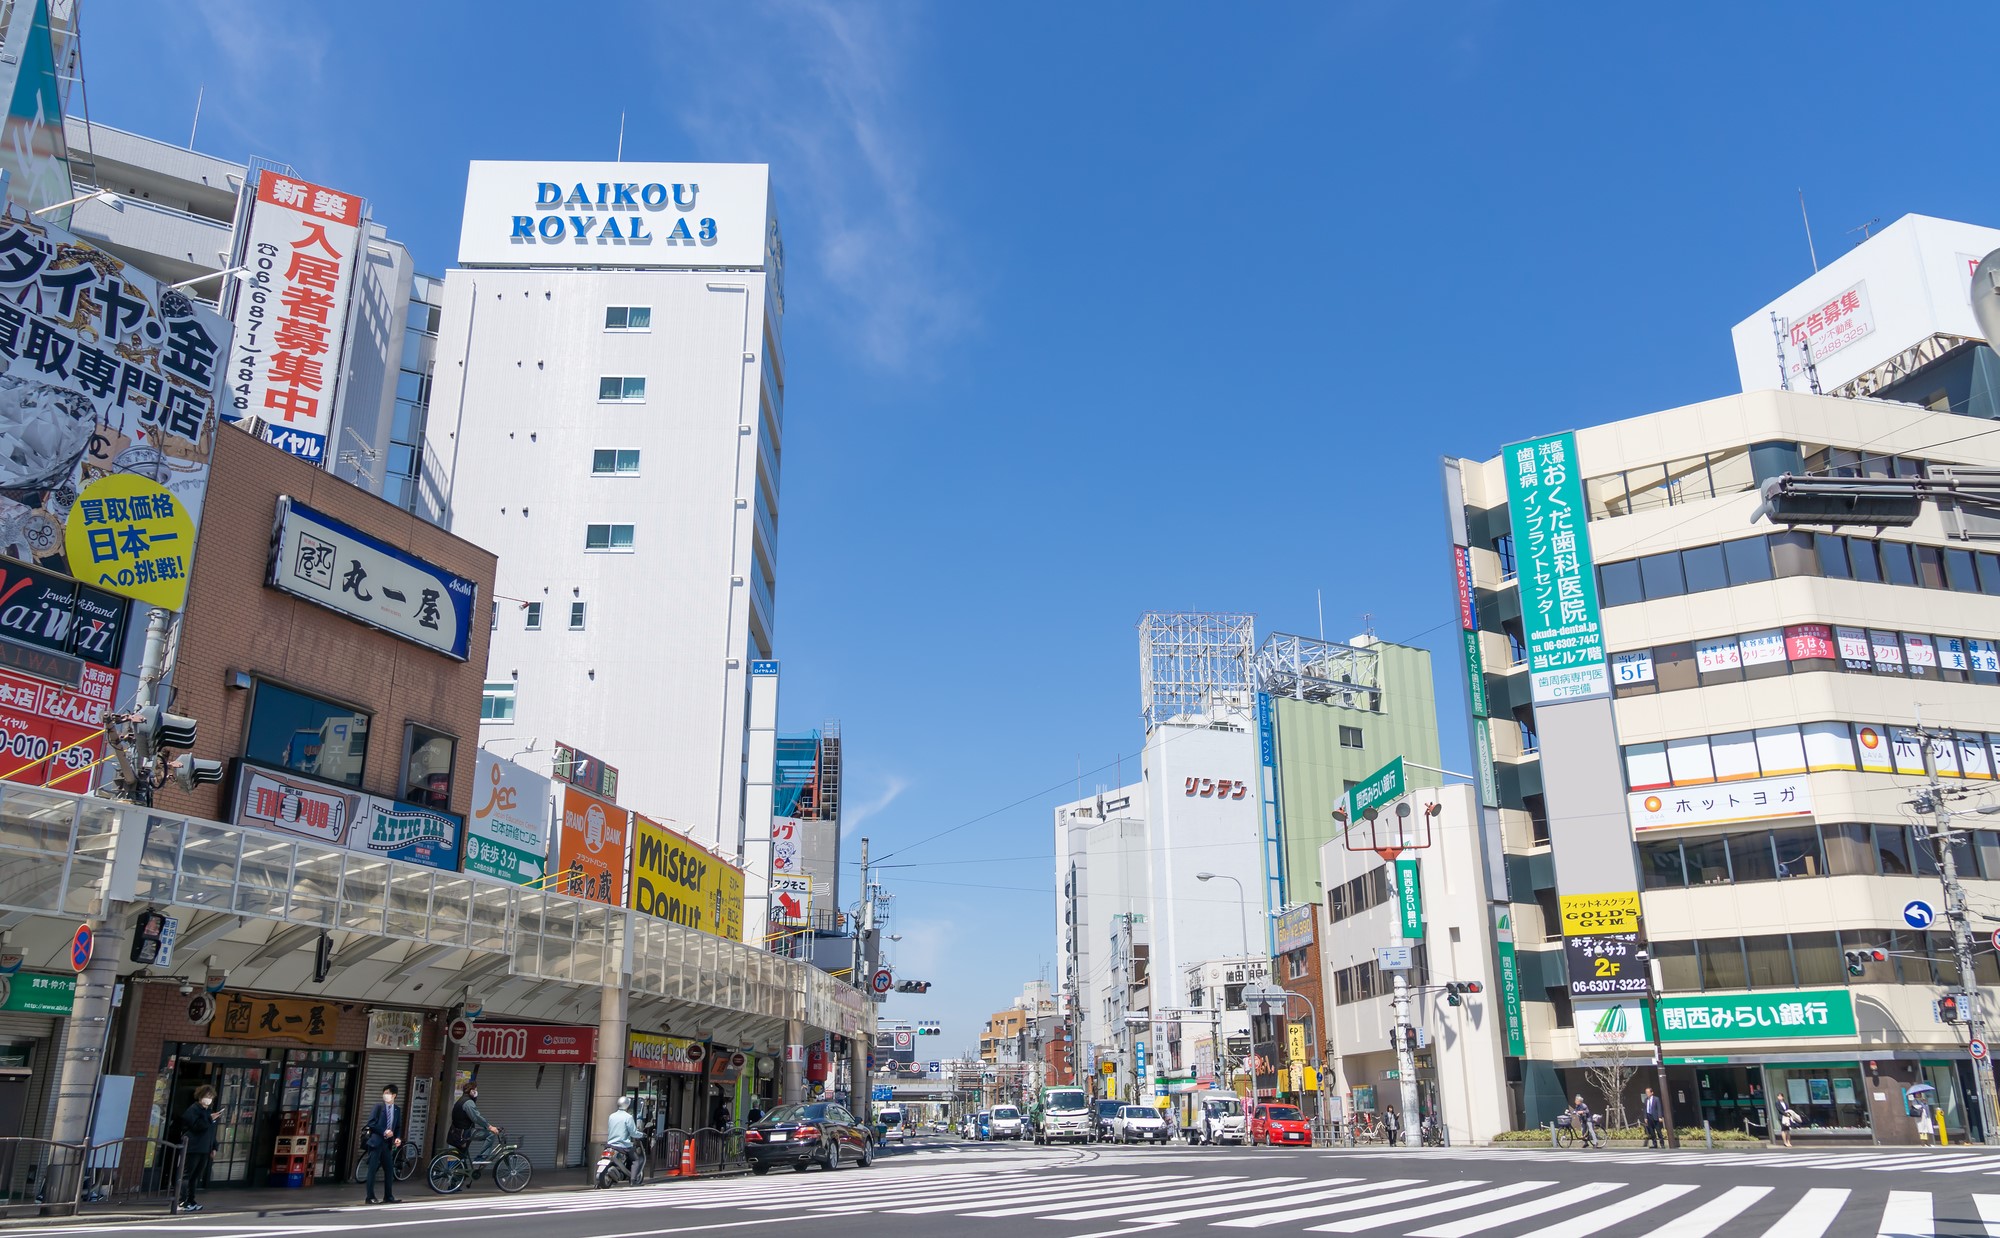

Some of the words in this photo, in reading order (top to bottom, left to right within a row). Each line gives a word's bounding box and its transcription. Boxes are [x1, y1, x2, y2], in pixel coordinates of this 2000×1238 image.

[272, 179, 348, 219] 新築
[535, 181, 699, 207] DAIKOU
[511, 215, 651, 240] ROYAL
[667, 216, 718, 240] A3
[0, 229, 219, 387] ダイヤ・金
[264, 220, 344, 422] 入居者募集中
[1790, 290, 1860, 347] 広告募集
[1538, 444, 1553, 466] 法人
[1549, 440, 1566, 464] 医療
[1516, 447, 1539, 489] 歯周病
[80, 493, 175, 527] 買取価格
[87, 525, 179, 564] 日本一
[1542, 464, 1588, 624] おくだ歯科医院
[1523, 490, 1553, 627] インプラントセンター
[342, 559, 442, 631] 丸一屋
[449, 578, 472, 597] Asahi
[1455, 548, 1470, 628] ちはるクリニック
[1531, 622, 1598, 641] okuda-dental.jp
[1532, 645, 1543, 653] TEL
[1544, 634, 1600, 651] 06-6302-7447
[1796, 638, 1826, 649] ちはる
[1533, 647, 1603, 669] 当ビル7階
[1618, 653, 1647, 664] 当ビル
[1703, 652, 1739, 667] ちはる
[1743, 646, 1785, 660] クリニック
[1796, 648, 1828, 657] クリニック
[1538, 669, 1604, 687] 歯周病専門医
[1620, 662, 1648, 682] 5F
[1553, 683, 1592, 697] CT完備
[1185, 776, 1248, 800] リンデン
[1356, 770, 1396, 811] 関西みらい銀行
[1675, 786, 1796, 813] ホットヨガ
[295, 797, 330, 829] PUB
[372, 815, 421, 842] ATTIC
[422, 818, 445, 838] BAR
[490, 818, 541, 847] 日本研修センター
[565, 810, 584, 832] BRAND
[605, 826, 622, 846] BANK
[480, 841, 517, 870] 徒歩3分
[1403, 869, 1417, 929] 関西みらい銀行
[1564, 897, 1635, 909] フィットネスクラブ
[1566, 908, 1638, 920] GOLD'S
[1579, 918, 1625, 928] GYM
[1383, 950, 1407, 960] 十三
[1594, 958, 1621, 977] 2F
[1502, 956, 1520, 1041] 関西みらい銀行
[1573, 978, 1647, 993] 06-6307-3222
[259, 1003, 326, 1036] 丸一屋
[1662, 1001, 1829, 1031] 関西みらい銀行
